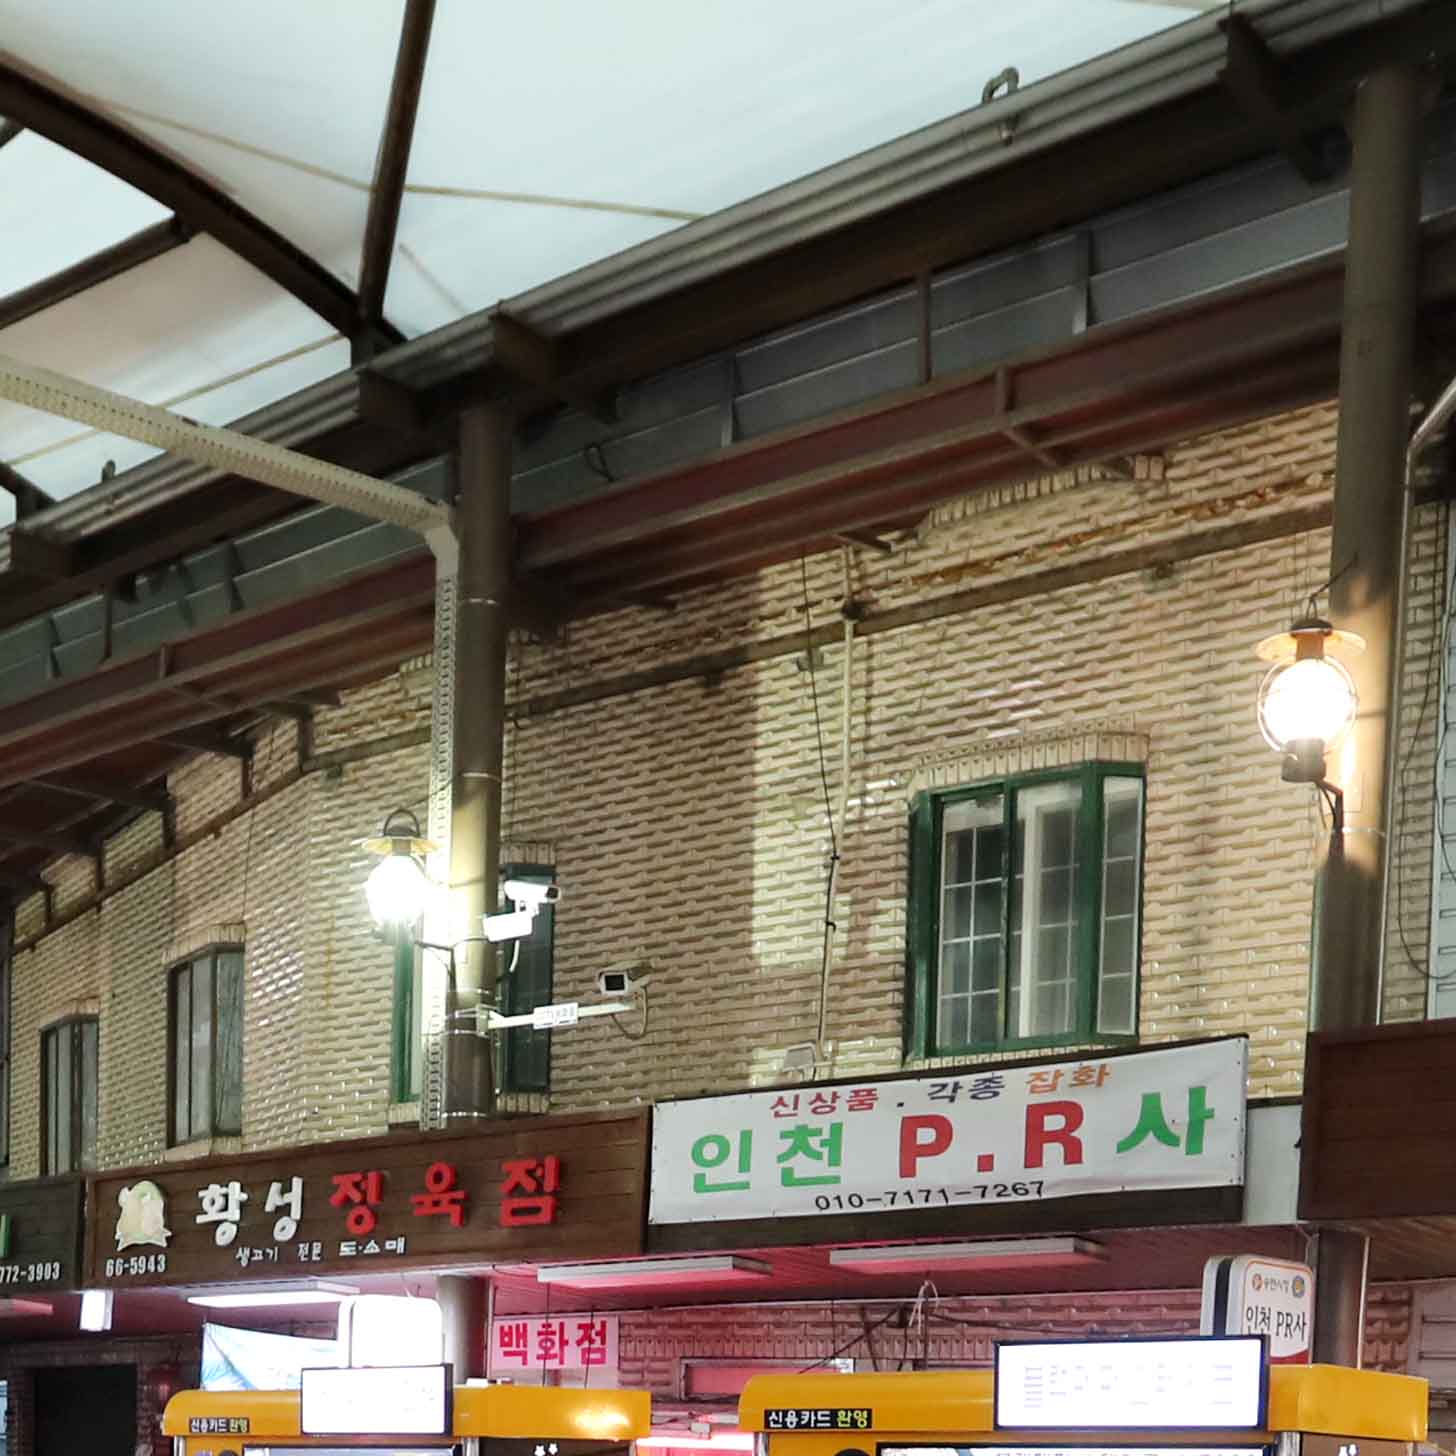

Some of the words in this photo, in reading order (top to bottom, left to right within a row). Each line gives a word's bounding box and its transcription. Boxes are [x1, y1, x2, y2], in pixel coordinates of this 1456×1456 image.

[768, 1085, 881, 1119] 신상품
[927, 1074, 1006, 1105] 각종
[1024, 1063, 1114, 1095] 잡화
[689, 1121, 846, 1194] 인천
[814, 1179, 1046, 1211] 010-7171-7267
[498, 1319, 608, 1367] 백화점
[768, 1410, 832, 1428] 신용카드
[836, 1410, 868, 1428] 환영
